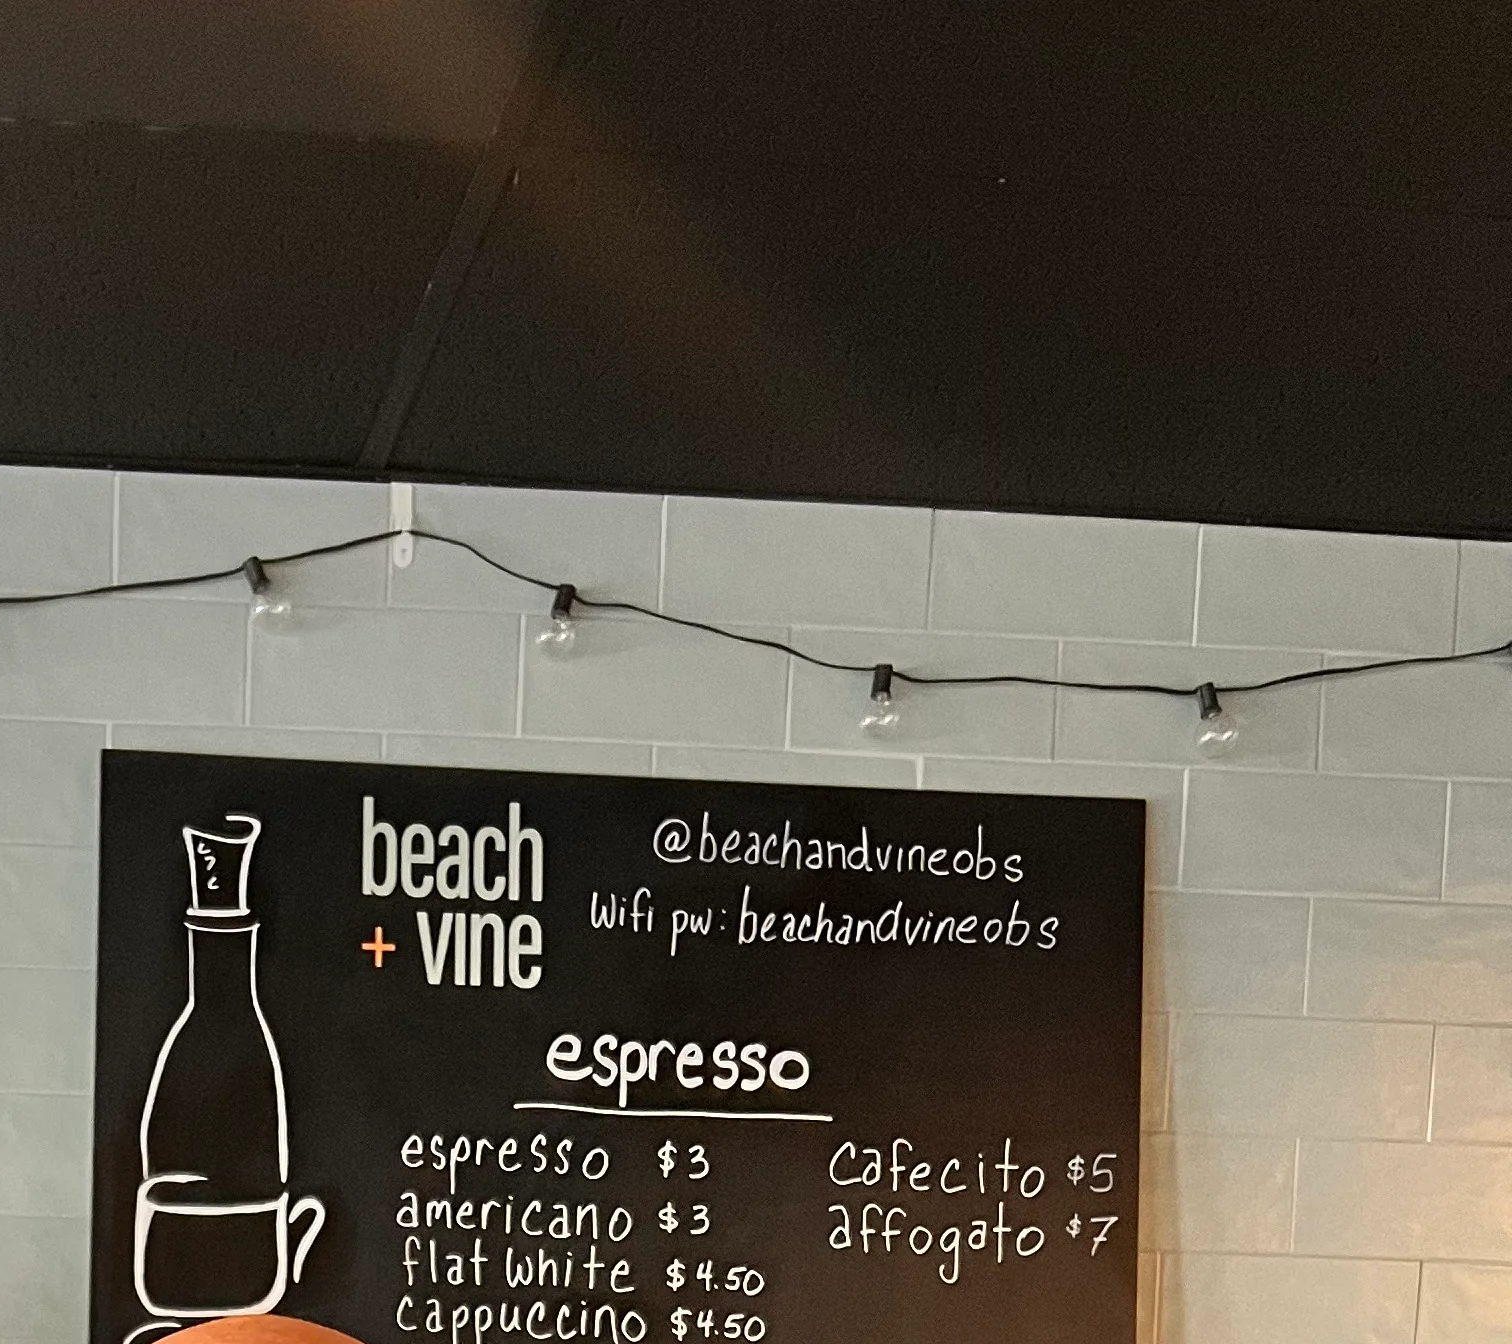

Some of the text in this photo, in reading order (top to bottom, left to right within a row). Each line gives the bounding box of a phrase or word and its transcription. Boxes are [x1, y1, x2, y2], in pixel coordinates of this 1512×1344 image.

[361, 796, 543, 902] beach
[654, 812, 1025, 882] @beachandvineobs
[416, 911, 543, 989] vine
[738, 885, 1060, 950] beachandvineobs
[546, 1033, 811, 1108] espresso
[400, 1133, 710, 1195] espresso $3
[1066, 1153, 1117, 1193] $5
[395, 1191, 711, 1242] americano $3
[828, 1201, 1119, 1285] affogato $7
[402, 1236, 765, 1297] flat white $4.50
[670, 1306, 767, 1342] $4.50
